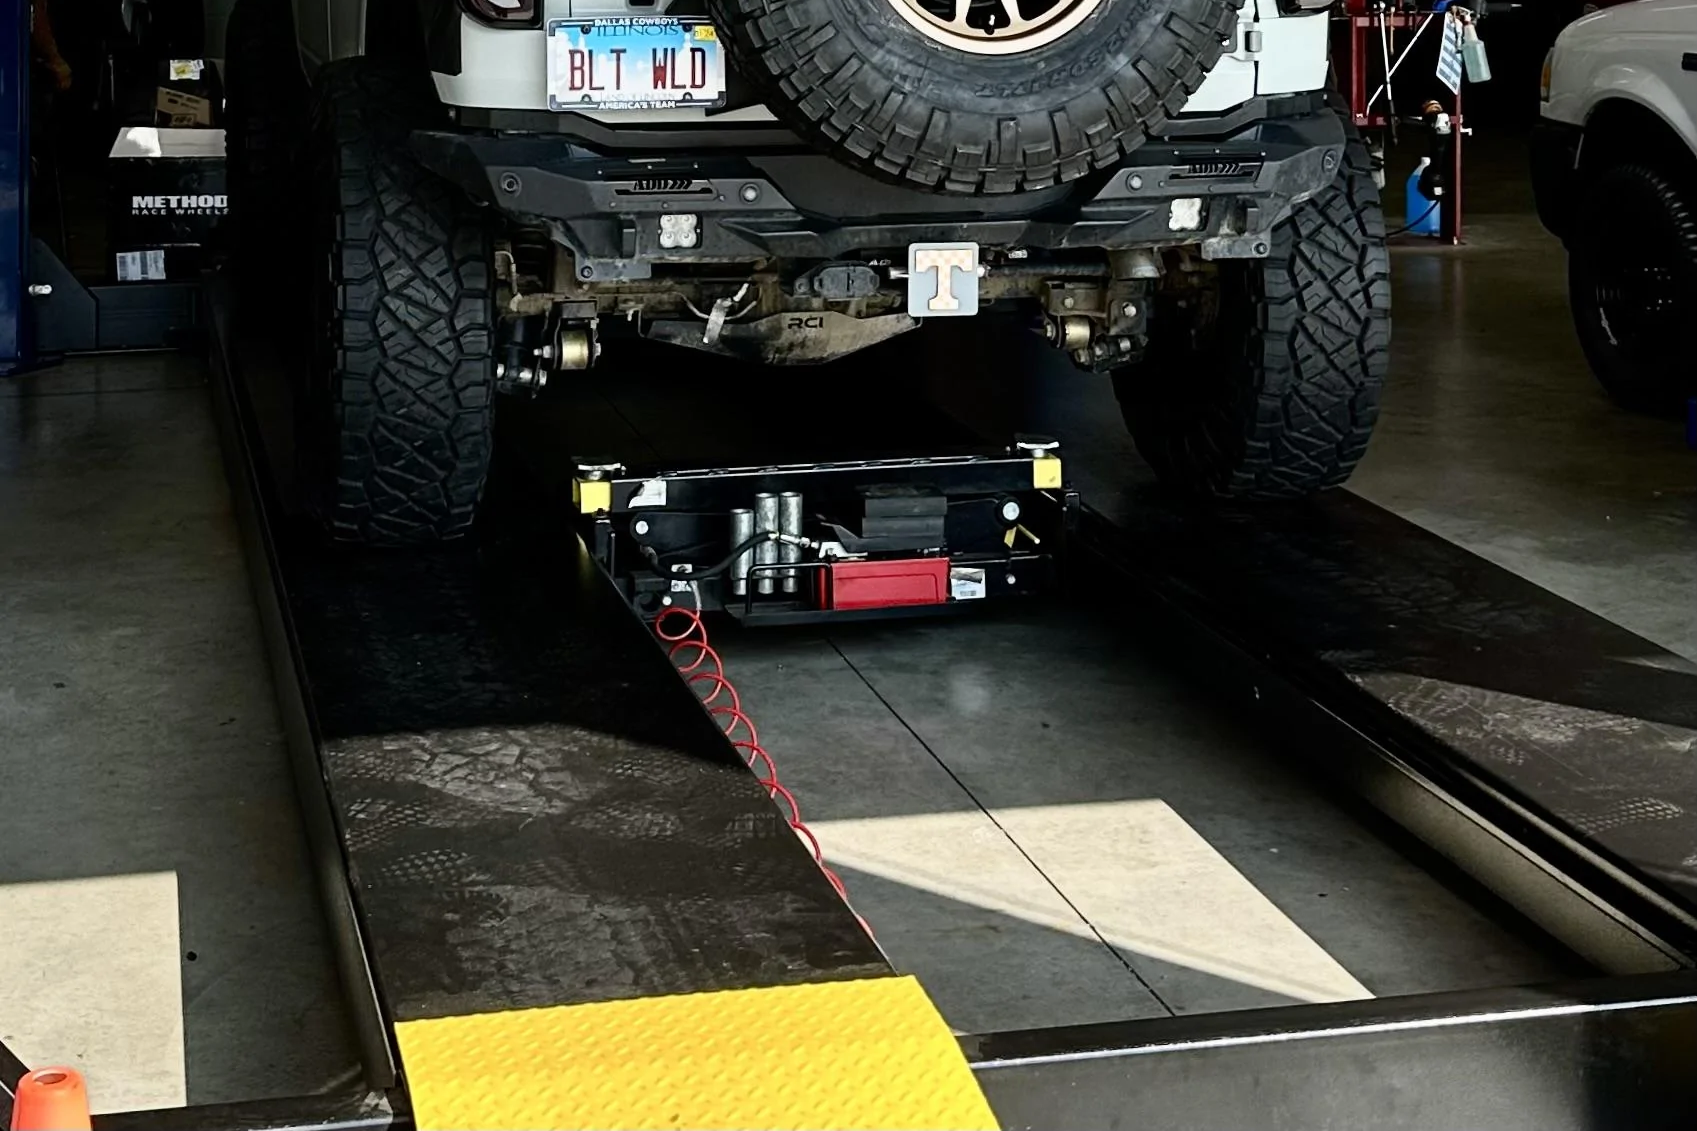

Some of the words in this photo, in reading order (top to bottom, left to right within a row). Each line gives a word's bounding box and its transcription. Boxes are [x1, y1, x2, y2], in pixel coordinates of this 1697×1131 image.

[596, 25, 680, 36] ILLINOIS
[568, 48, 627, 91] BLT
[652, 47, 706, 90] WLD
[599, 101, 647, 109] AMERICA'S
[648, 100, 676, 108] TEAM
[132, 194, 228, 208] METHOD
[131, 208, 167, 216] RACE
[175, 208, 230, 216] WHEELS
[915, 249, 973, 310] T
[787, 316, 824, 329] RCI
